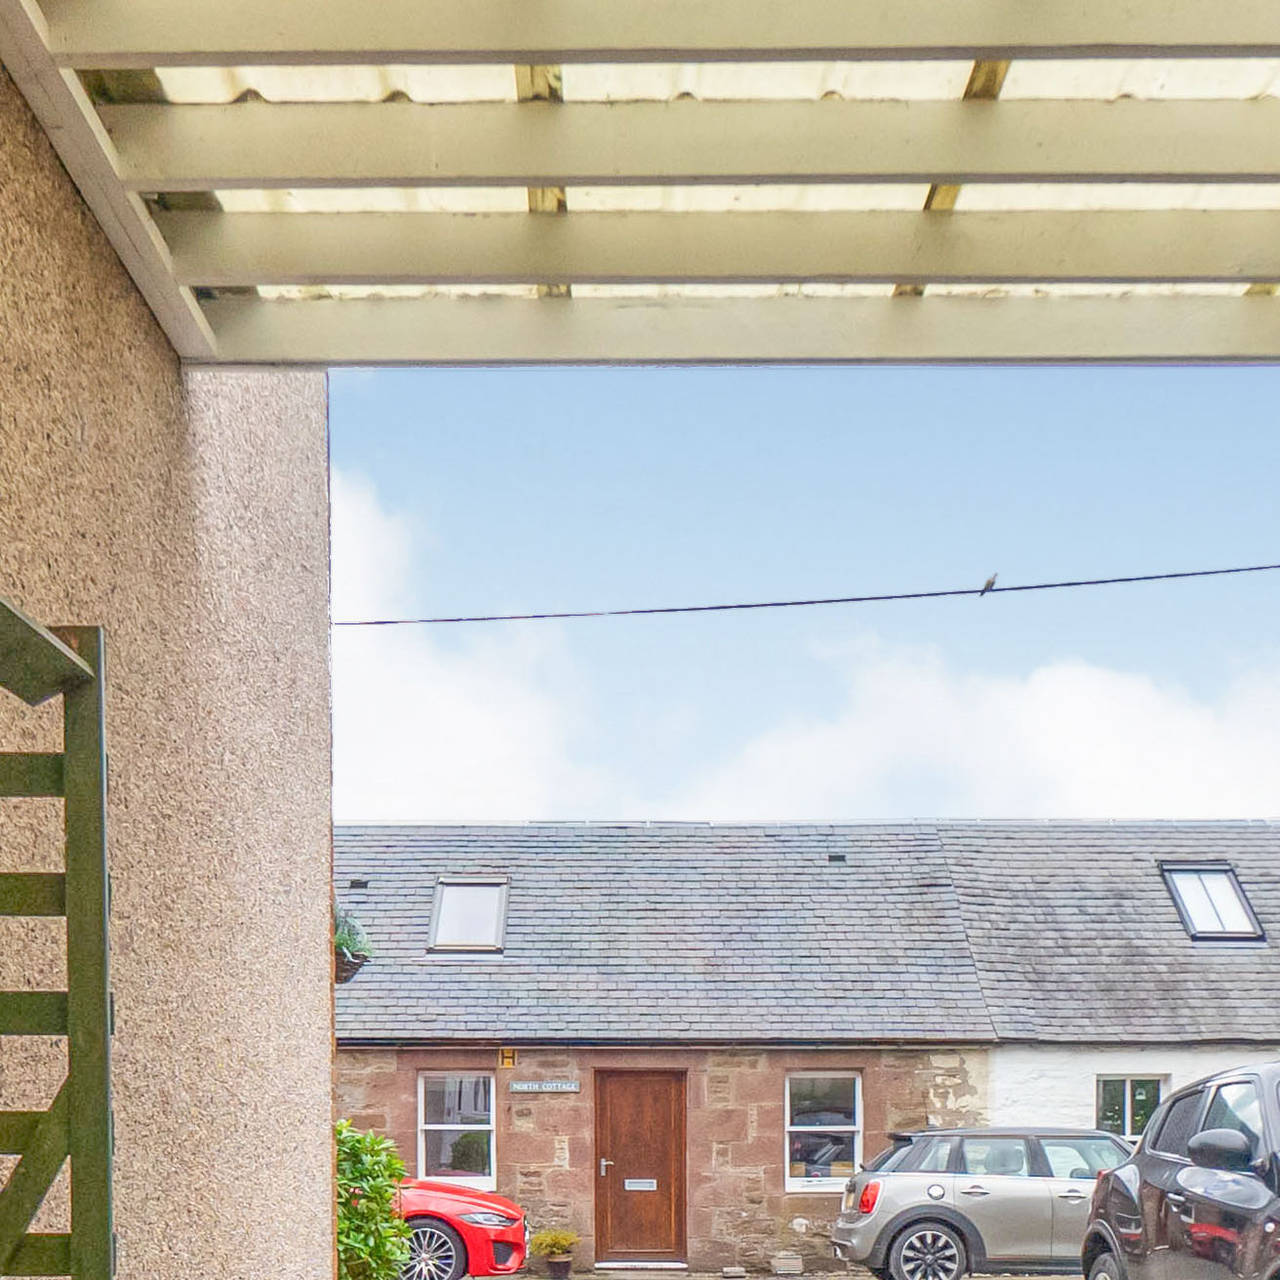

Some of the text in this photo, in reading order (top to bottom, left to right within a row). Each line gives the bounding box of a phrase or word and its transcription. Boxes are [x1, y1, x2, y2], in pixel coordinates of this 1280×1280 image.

[501, 1049, 516, 1066] H
[512, 1082, 578, 1090] NORTH COTTAGE
